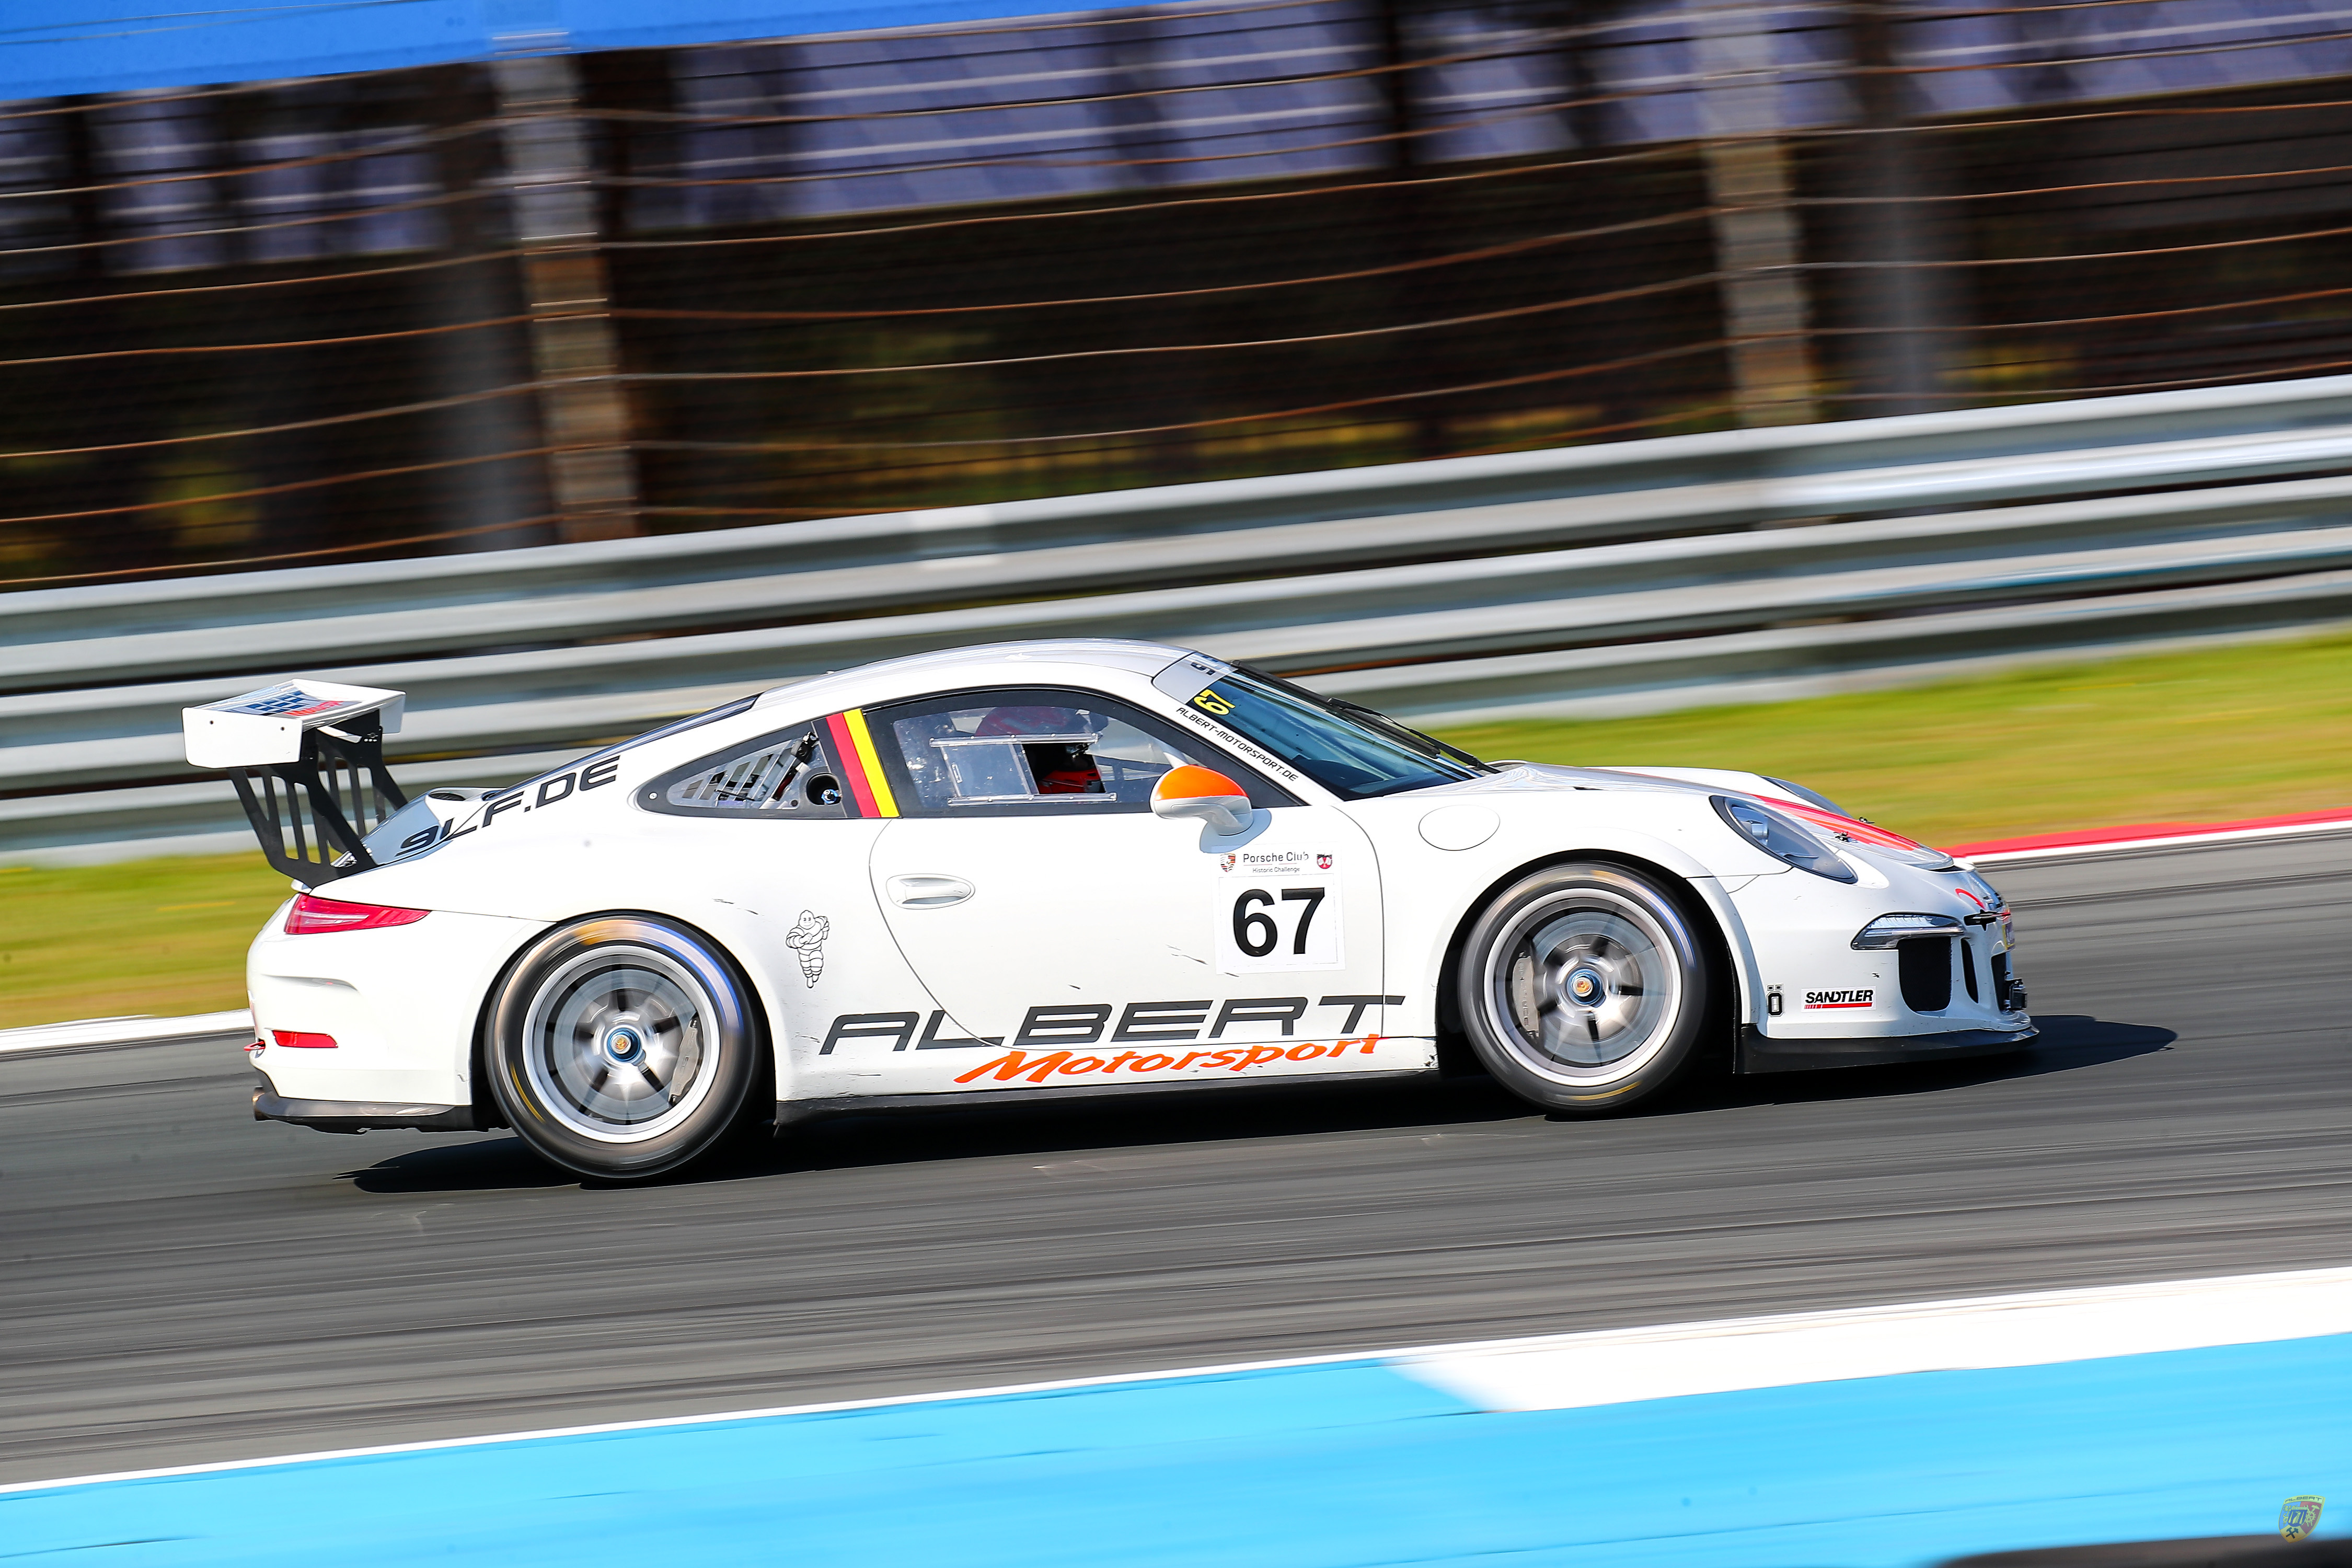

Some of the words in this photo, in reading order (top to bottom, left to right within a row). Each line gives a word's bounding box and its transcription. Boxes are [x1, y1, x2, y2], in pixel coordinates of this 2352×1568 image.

[1193, 689, 1236, 715] 67
[1175, 707, 1299, 781] ALBERT-MOTORSPORT.DE
[1243, 853, 1284, 863] Porsche
[1232, 886, 1325, 957] 67
[1805, 989, 1874, 1004] SANDTLER
[819, 995, 1406, 1055] ALBERT
[953, 1033, 1388, 1084] Motorsport
